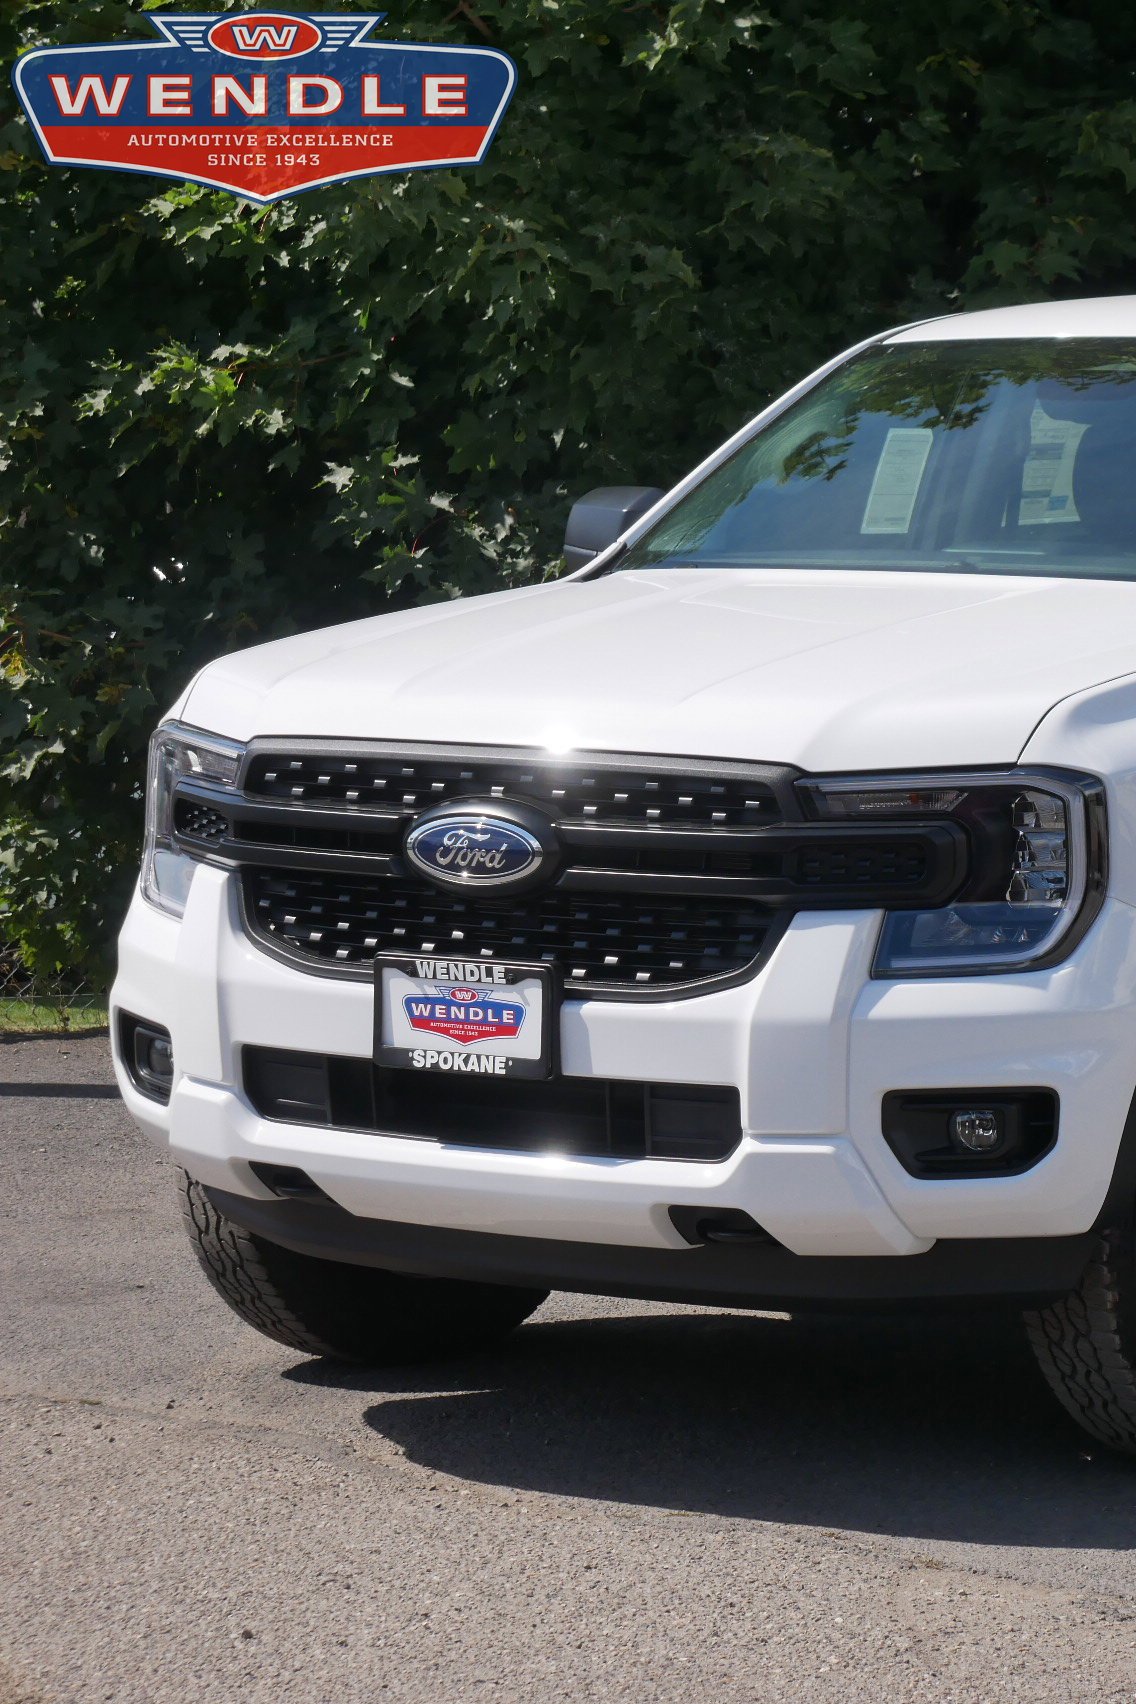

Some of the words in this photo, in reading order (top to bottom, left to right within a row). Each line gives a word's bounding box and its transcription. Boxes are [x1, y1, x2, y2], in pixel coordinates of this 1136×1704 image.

[436, 830, 507, 869] Ford
[416, 960, 507, 984] WENDLE
[411, 1002, 515, 1024] WENDLE
[412, 1049, 507, 1075] SPOKANE
